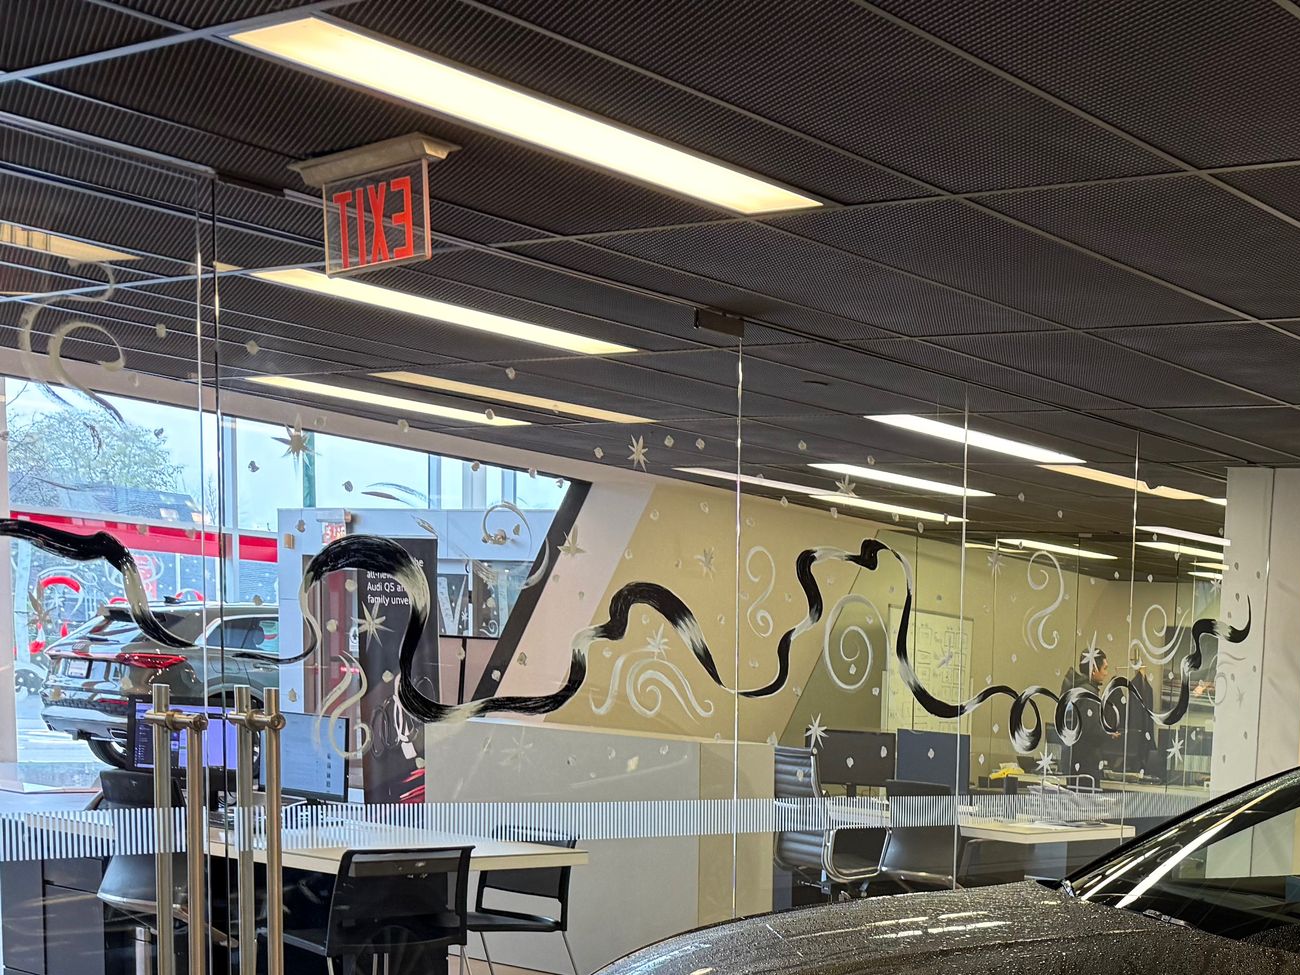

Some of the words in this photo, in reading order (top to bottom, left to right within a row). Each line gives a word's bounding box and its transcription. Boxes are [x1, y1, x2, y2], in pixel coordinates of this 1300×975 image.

[367, 582, 383, 591] Audi
[367, 594, 390, 606] family
[391, 596, 410, 605] unve
